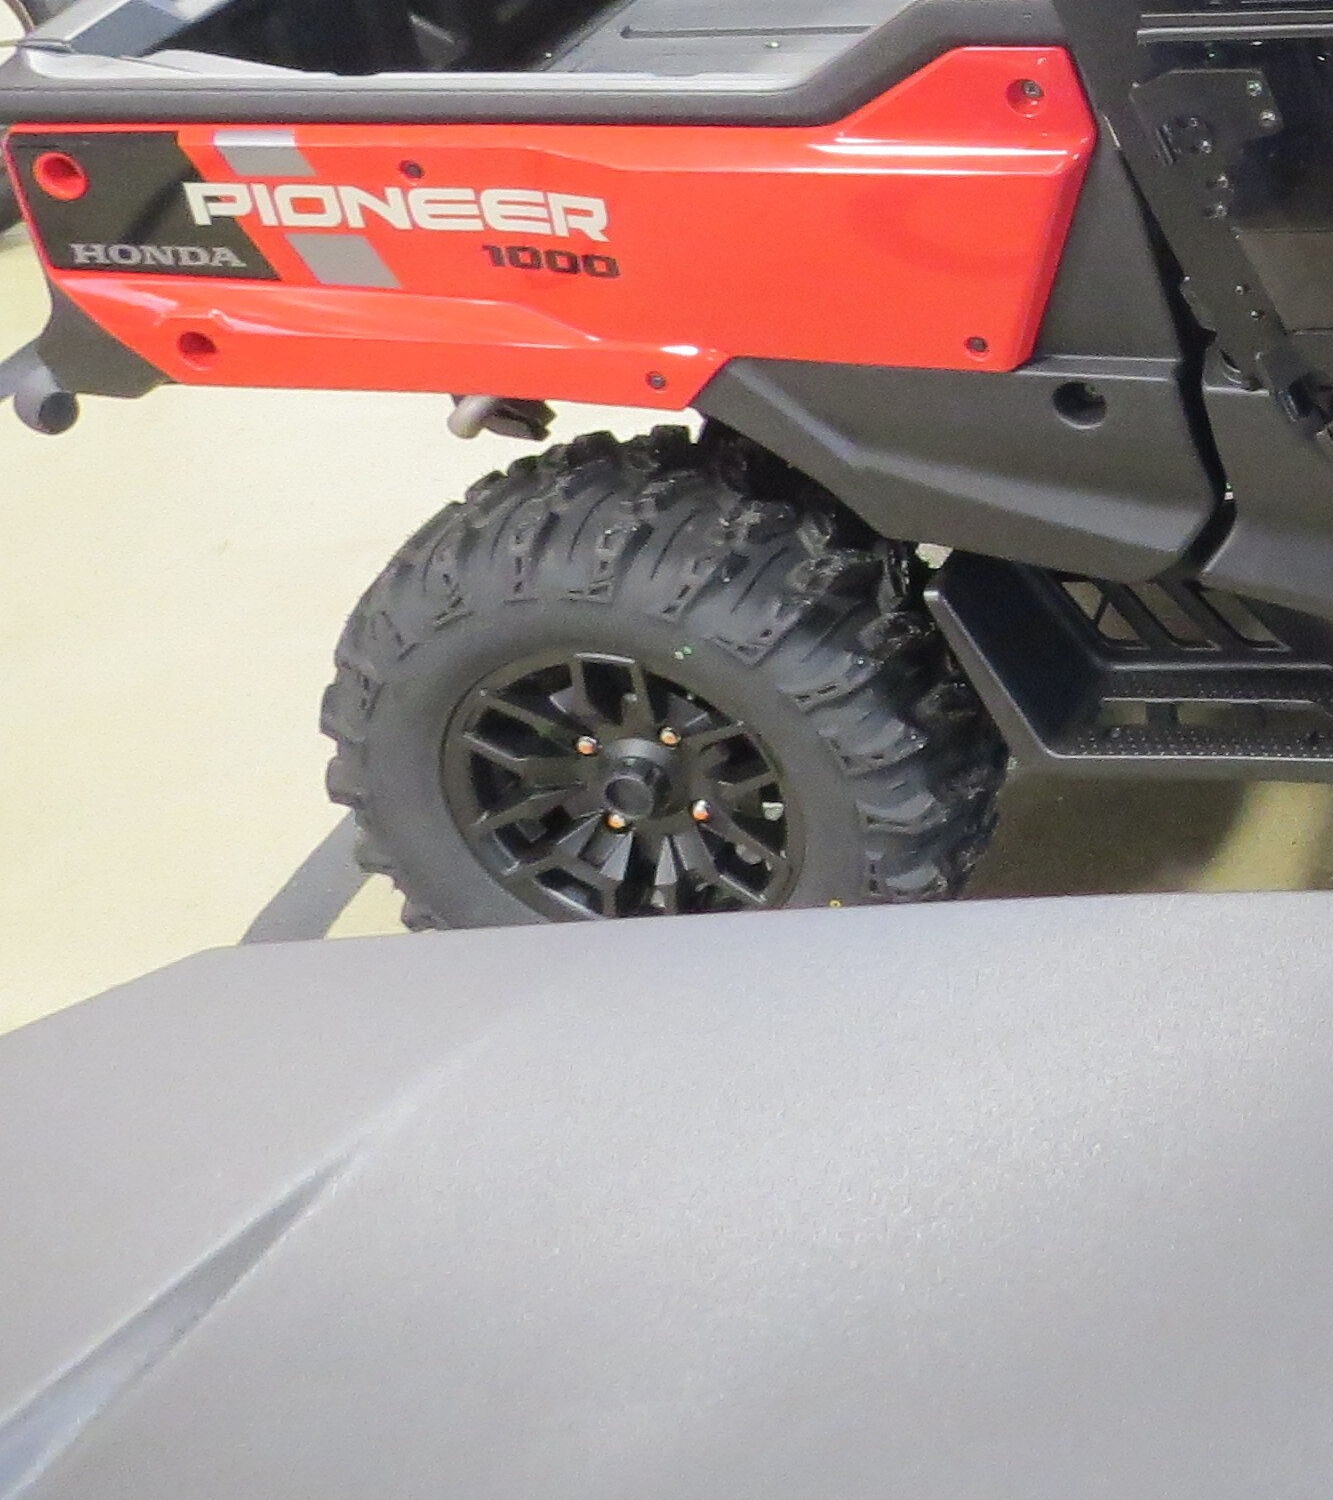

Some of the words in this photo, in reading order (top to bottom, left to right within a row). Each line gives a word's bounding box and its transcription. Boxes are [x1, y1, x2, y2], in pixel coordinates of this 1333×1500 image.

[183, 181, 609, 242] PIONEER
[70, 241, 247, 268] HONDA
[481, 243, 620, 279] 1000
